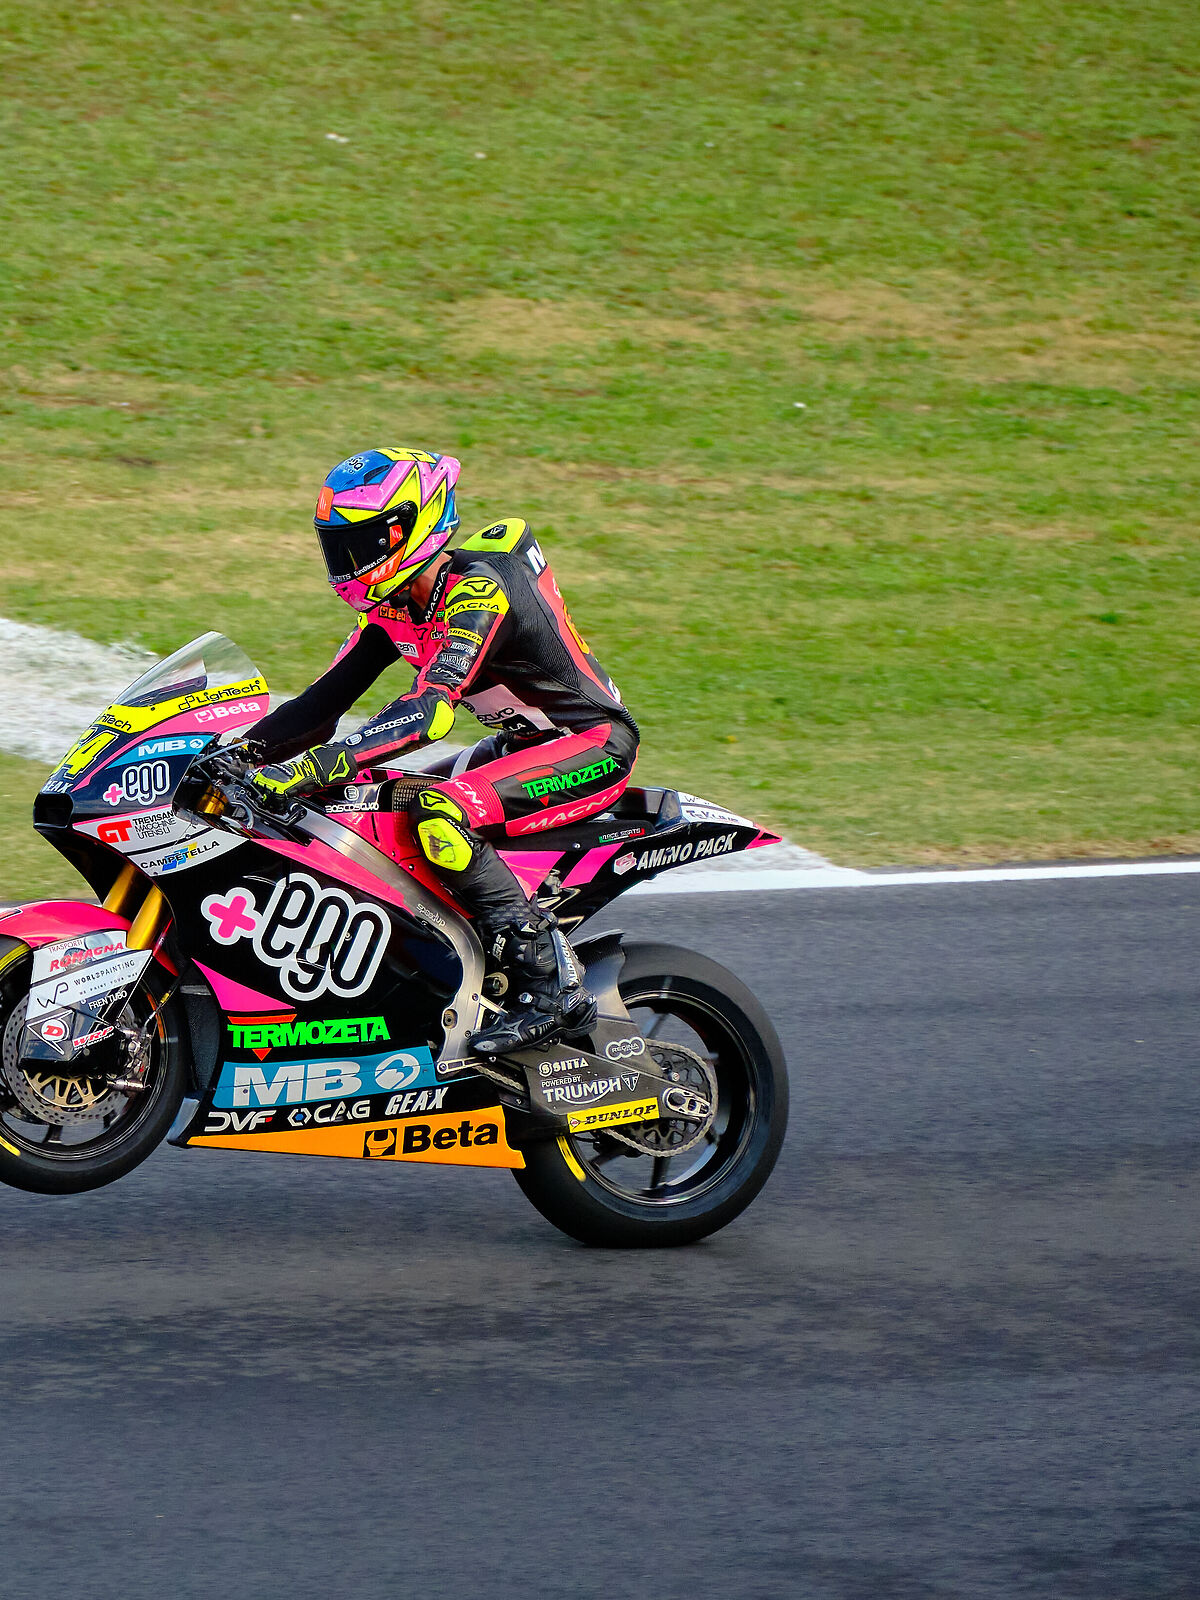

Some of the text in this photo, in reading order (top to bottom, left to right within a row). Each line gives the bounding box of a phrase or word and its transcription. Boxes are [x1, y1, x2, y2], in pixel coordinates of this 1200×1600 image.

[370, 557, 398, 583] MT
[215, 702, 261, 719] Beta
[138, 739, 187, 757] MB
[521, 756, 621, 799] TERMOZETA
[132, 810, 176, 826] TREVISAN
[520, 788, 620, 832] MACNA
[96, 819, 133, 844] GT
[134, 817, 177, 834] MACCHINE
[137, 827, 171, 841] UTENSILI
[140, 839, 220, 869] CAMPETELLA
[636, 831, 738, 871] AMINO PACK
[49, 939, 83, 954] TRASPORTI
[49, 942, 125, 972] ROMAGNA
[88, 989, 128, 1011] FREN TUBO
[227, 1016, 391, 1048] TERMOZETA
[553, 1057, 589, 1073] SITTA
[233, 1061, 362, 1107] MB
[541, 1075, 581, 1088] POWERED BY
[542, 1077, 622, 1104] TRIUMPH
[385, 1087, 448, 1116] GEAX
[204, 1110, 276, 1132] DVF
[584, 1104, 657, 1125] DUNLOP
[402, 1120, 499, 1155] Beta
